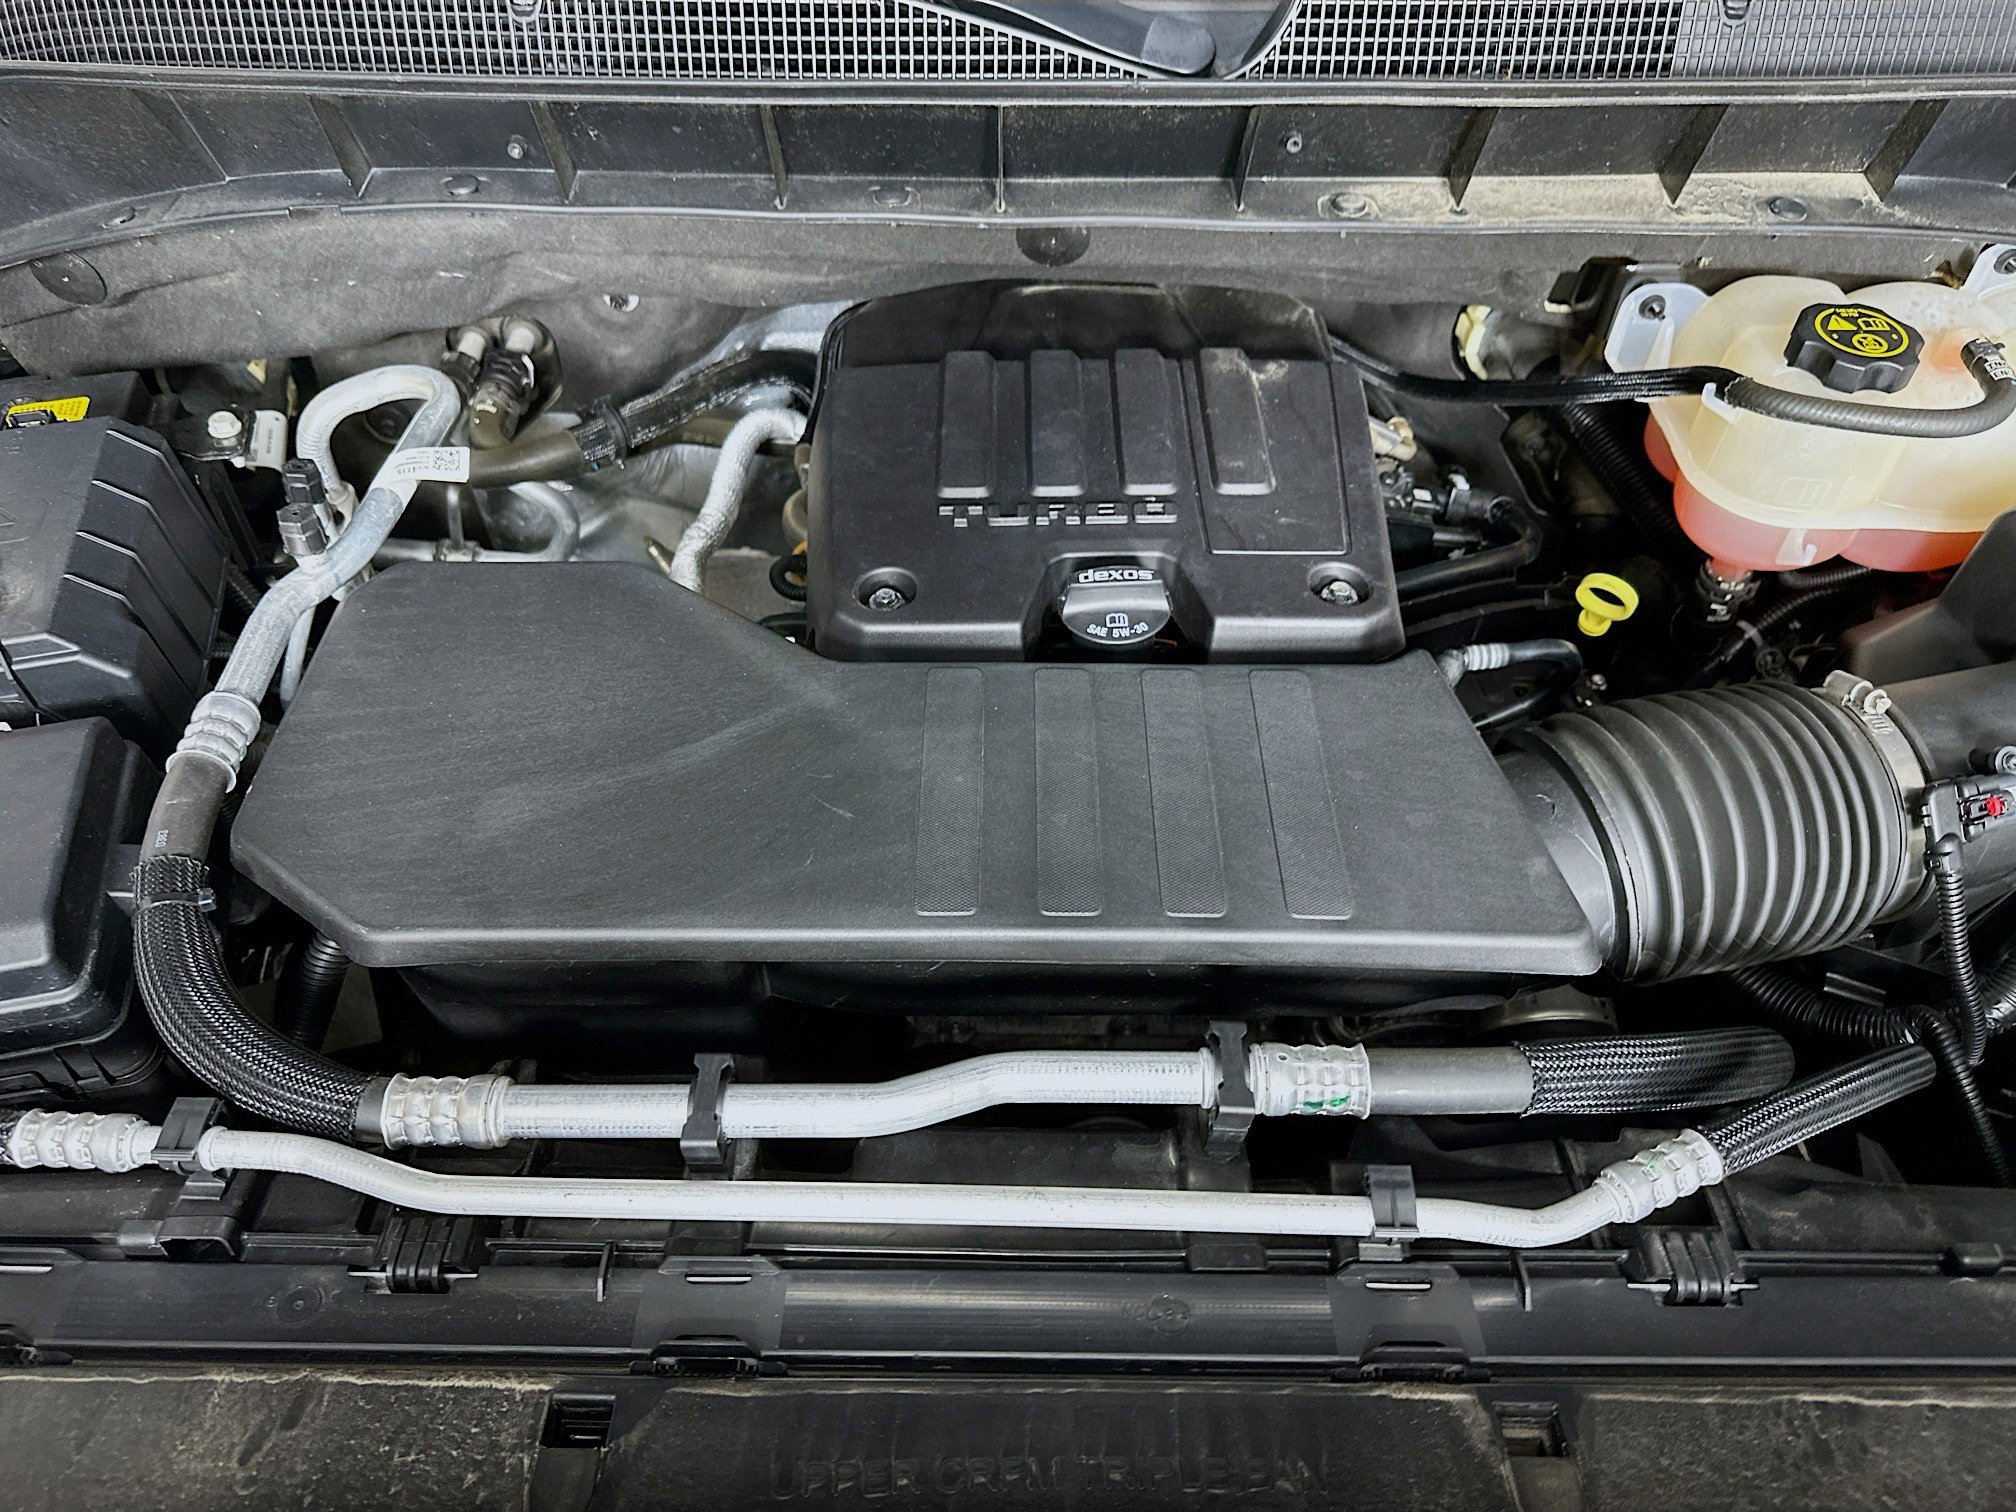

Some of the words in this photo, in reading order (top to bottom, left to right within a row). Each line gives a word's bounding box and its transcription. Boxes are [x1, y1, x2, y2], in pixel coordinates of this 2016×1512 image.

[938, 502, 1178, 528] TURBO
[1078, 568, 1155, 584] dexos
[1086, 623, 1108, 638] SAE
[1111, 621, 1149, 638] 5W-30
[769, 1456, 922, 1500] UPPER
